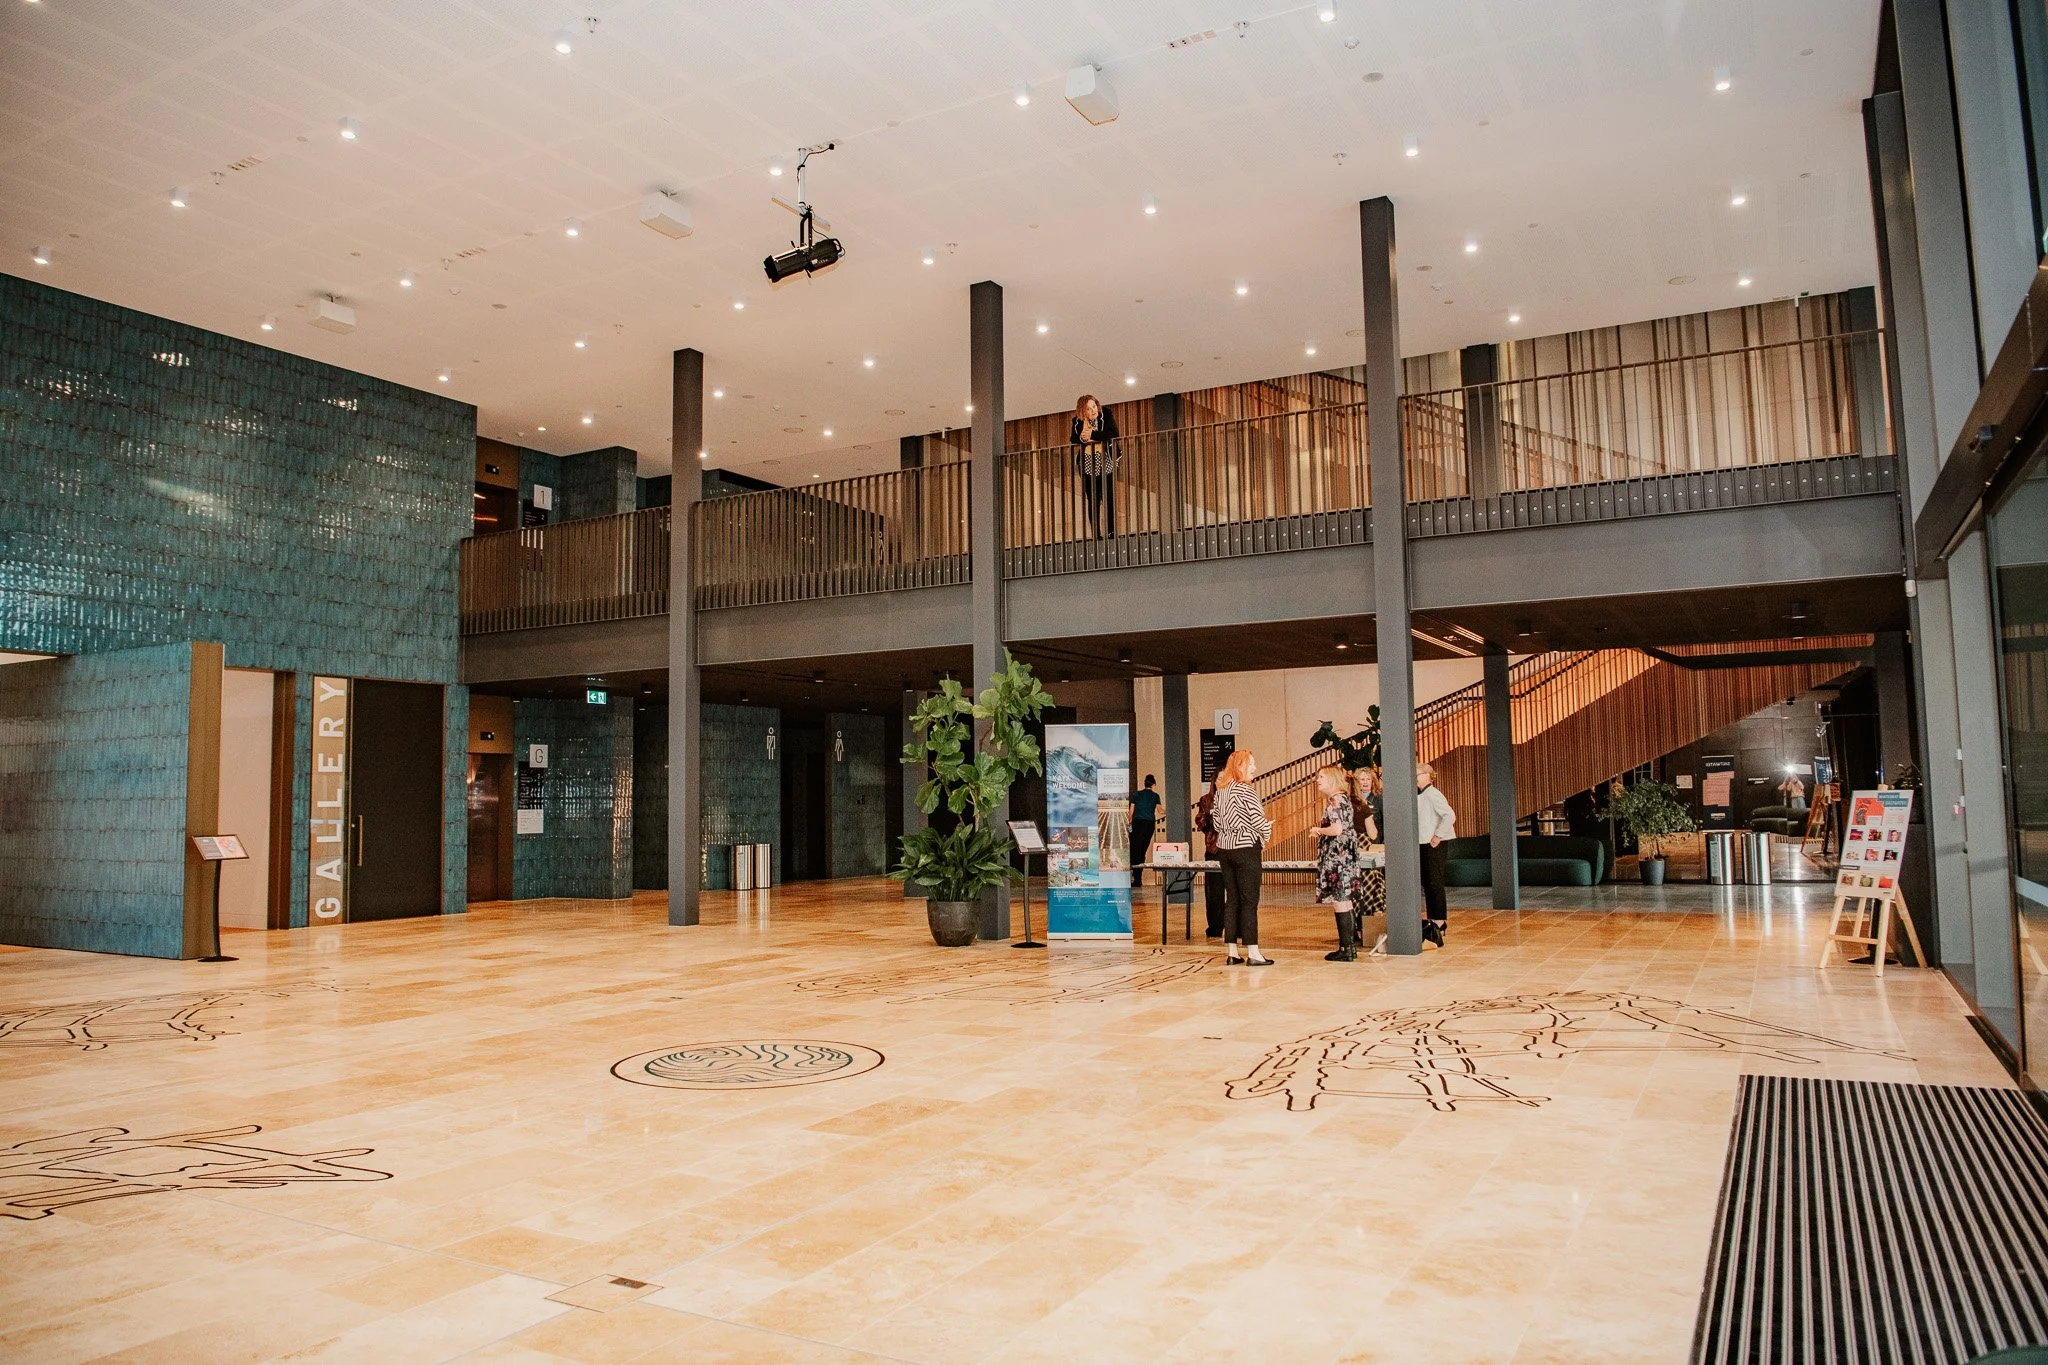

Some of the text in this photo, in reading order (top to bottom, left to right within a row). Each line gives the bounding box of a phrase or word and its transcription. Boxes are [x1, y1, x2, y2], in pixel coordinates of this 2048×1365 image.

[1221, 713, 1233, 730] G
[535, 748, 544, 764] G
[315, 680, 345, 919] GALLERY
